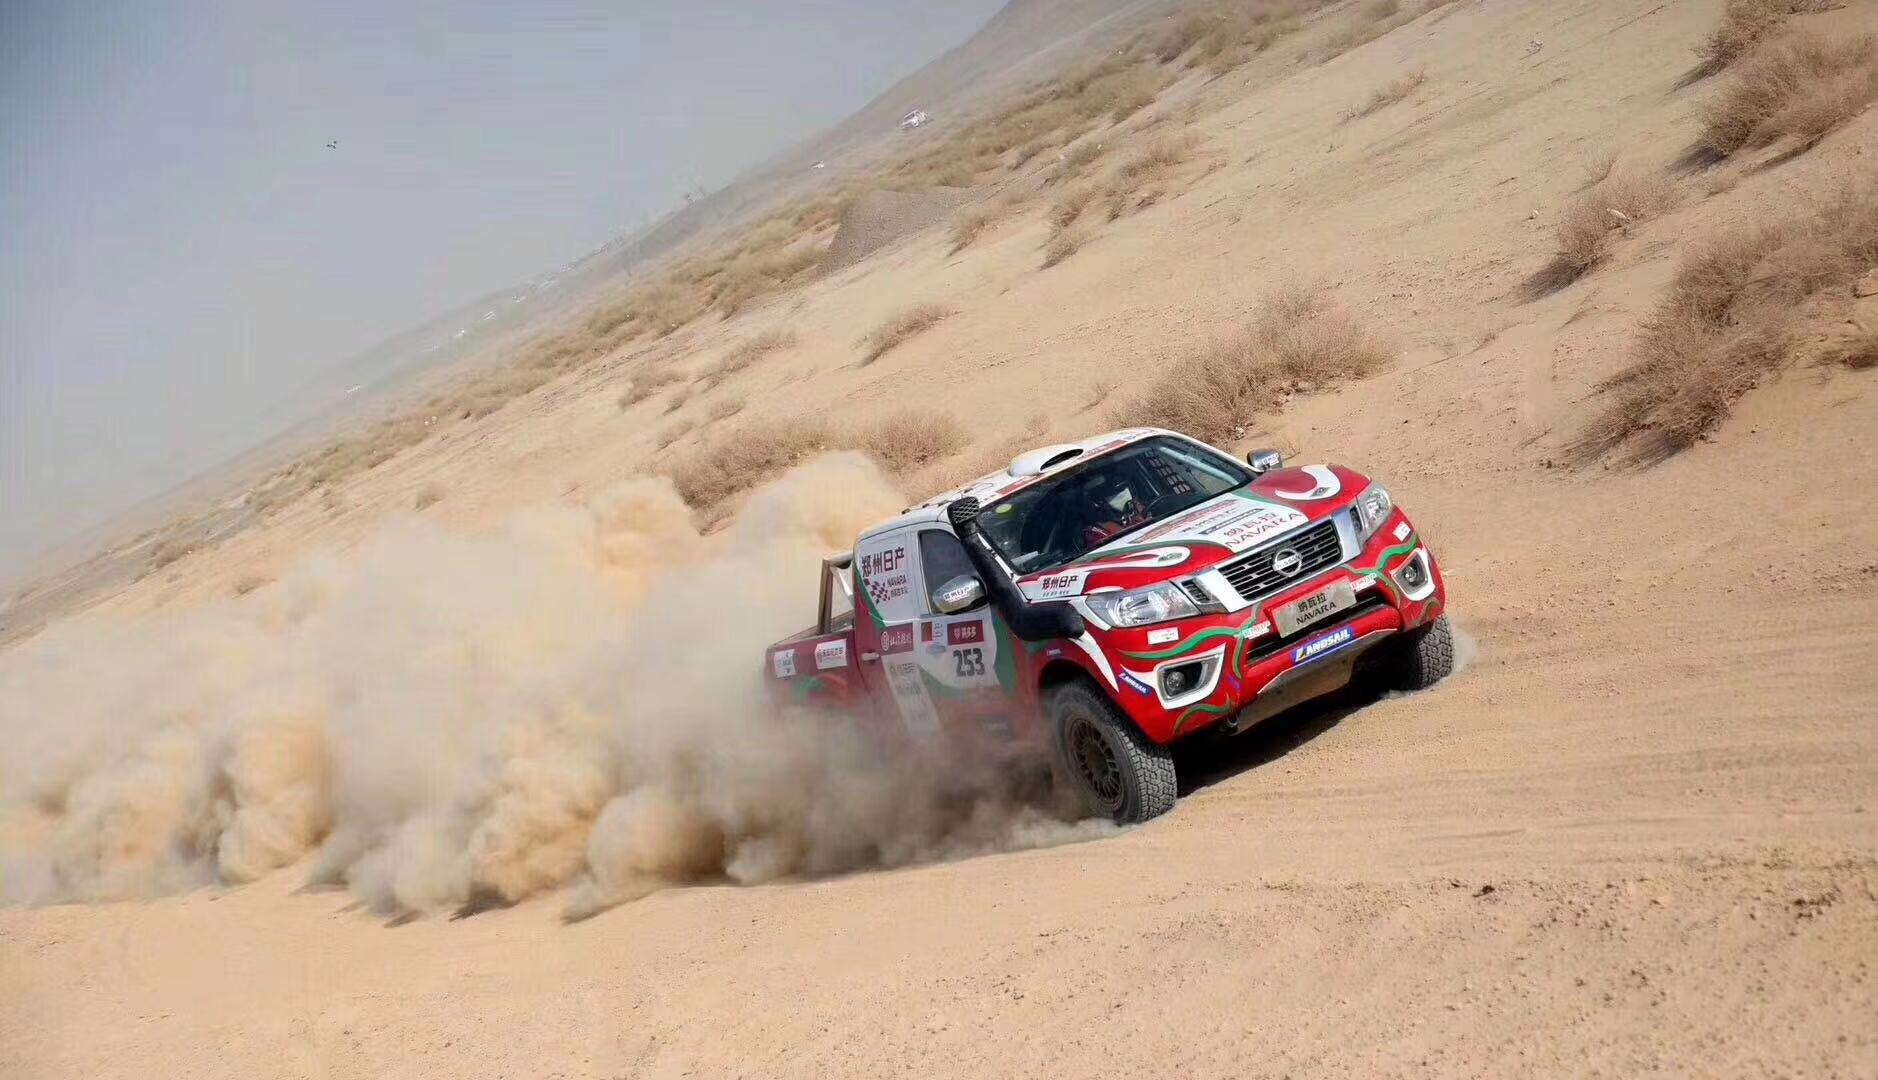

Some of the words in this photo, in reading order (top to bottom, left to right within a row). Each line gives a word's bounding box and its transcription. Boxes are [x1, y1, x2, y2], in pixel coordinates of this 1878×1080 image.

[1225, 512, 1302, 547] NAVARA
[861, 546, 905, 577] 郑州日产
[1296, 603, 1338, 625] NAVARA
[1297, 592, 1328, 612] 纳瓦拉
[1294, 628, 1351, 663] LANDSAIL
[953, 647, 985, 677] 253
